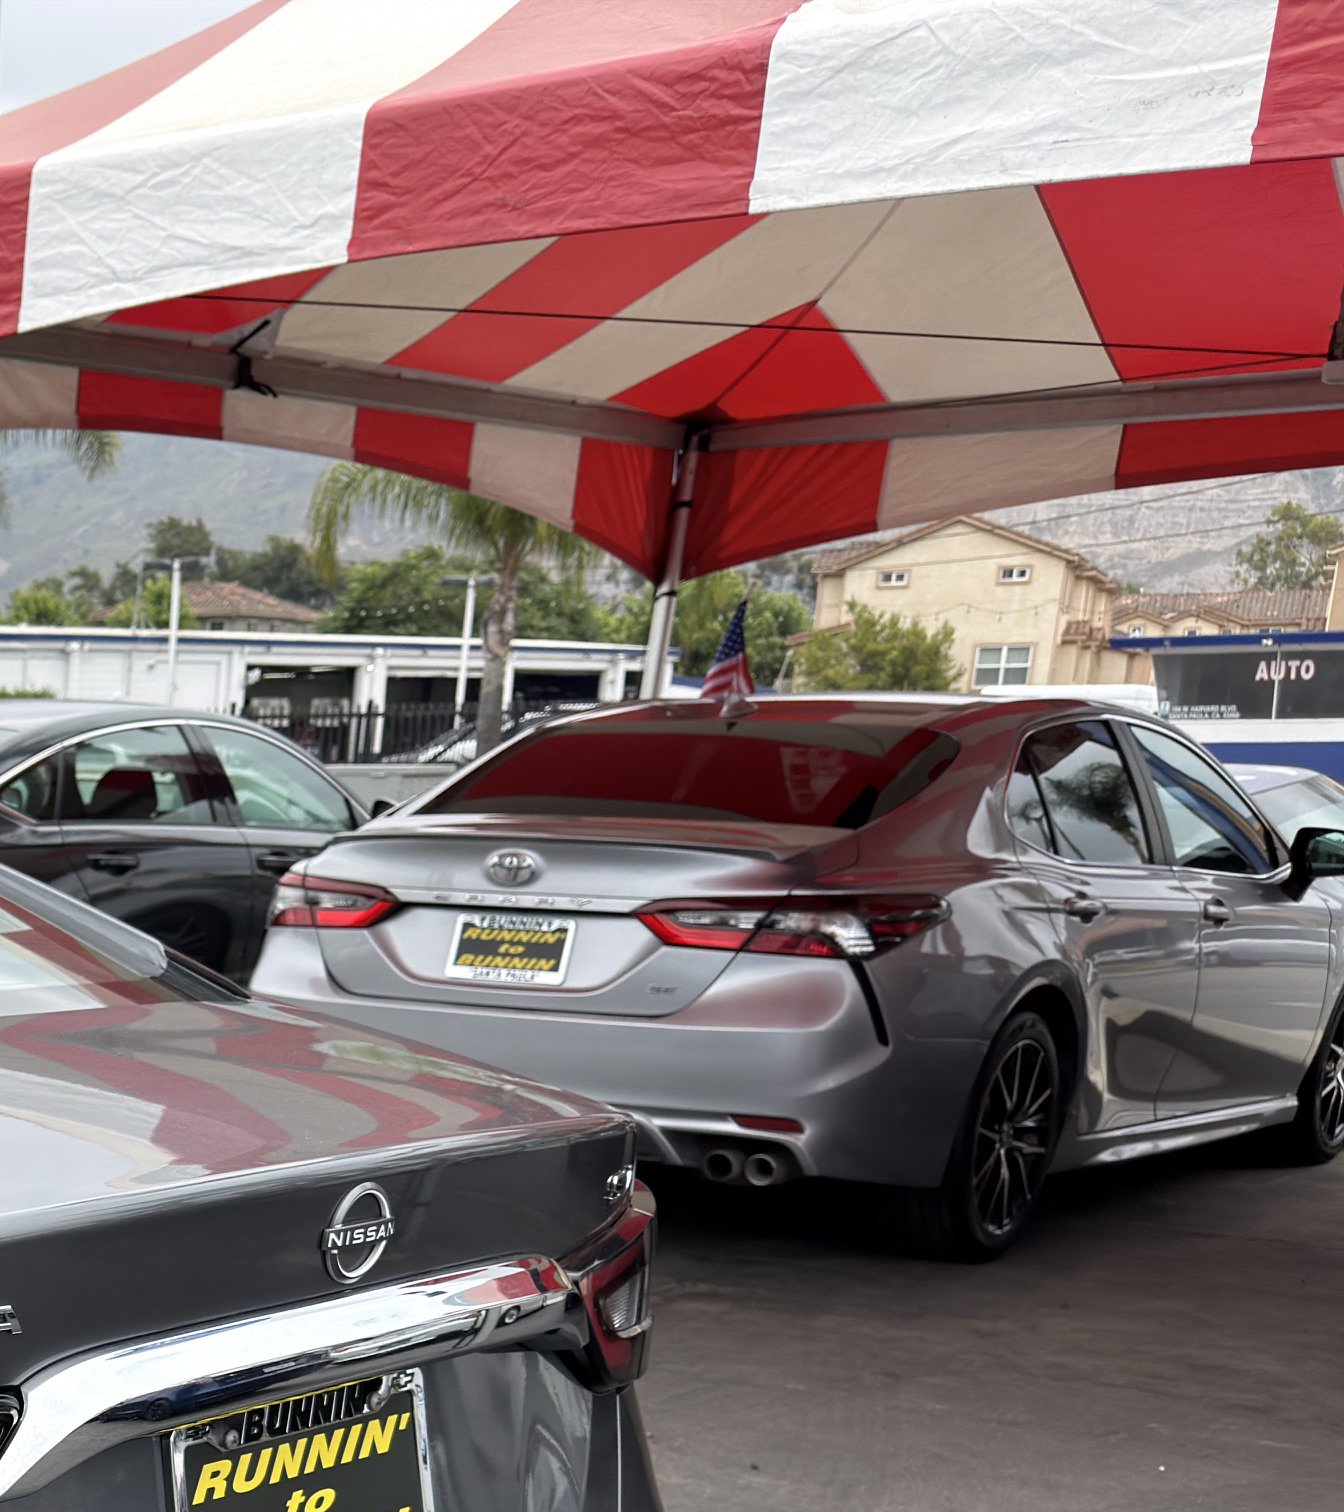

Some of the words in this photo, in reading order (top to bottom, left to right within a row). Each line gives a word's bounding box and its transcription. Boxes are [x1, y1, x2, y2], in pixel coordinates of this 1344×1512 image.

[1255, 659, 1315, 681] AUTO
[498, 943, 525, 954] to
[456, 954, 557, 971] BUNNIN
[328, 1222, 394, 1247] NISSAN
[241, 1385, 364, 1444] BUNNIN
[192, 1412, 410, 1505] RUNNIN'
